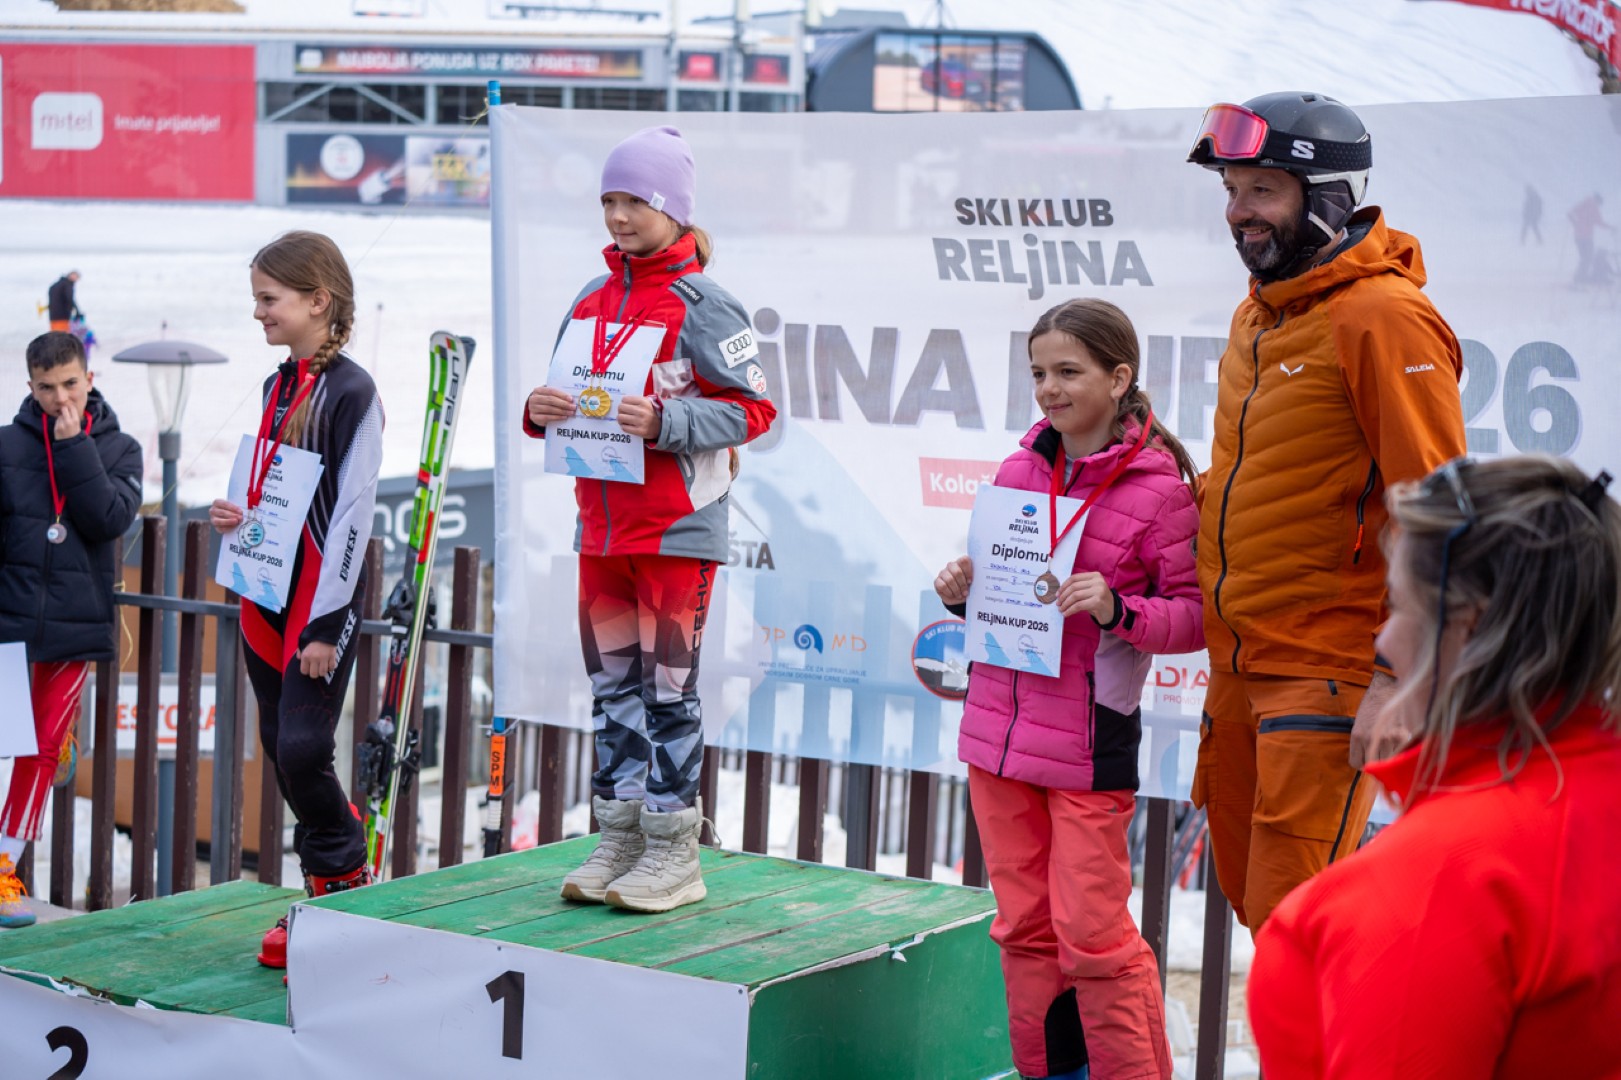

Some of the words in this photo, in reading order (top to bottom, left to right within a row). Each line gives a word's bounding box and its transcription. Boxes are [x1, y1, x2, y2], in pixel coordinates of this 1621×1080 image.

[410, 52, 475, 70] PONUDA
[955, 197, 1010, 226] SKI
[1018, 198, 1114, 227] KLUB
[1405, 363, 1435, 373] SALEWA
[592, 430, 610, 441] KUP
[610, 433, 631, 444] 2026
[253, 549, 267, 563] KUP
[267, 555, 283, 568] 2026
[992, 543, 1048, 563] Diplomu
[1008, 615, 1027, 628] KUP
[1027, 619, 1049, 632] 2026
[485, 970, 524, 1059] 1
[45, 1026, 89, 1080] 2
